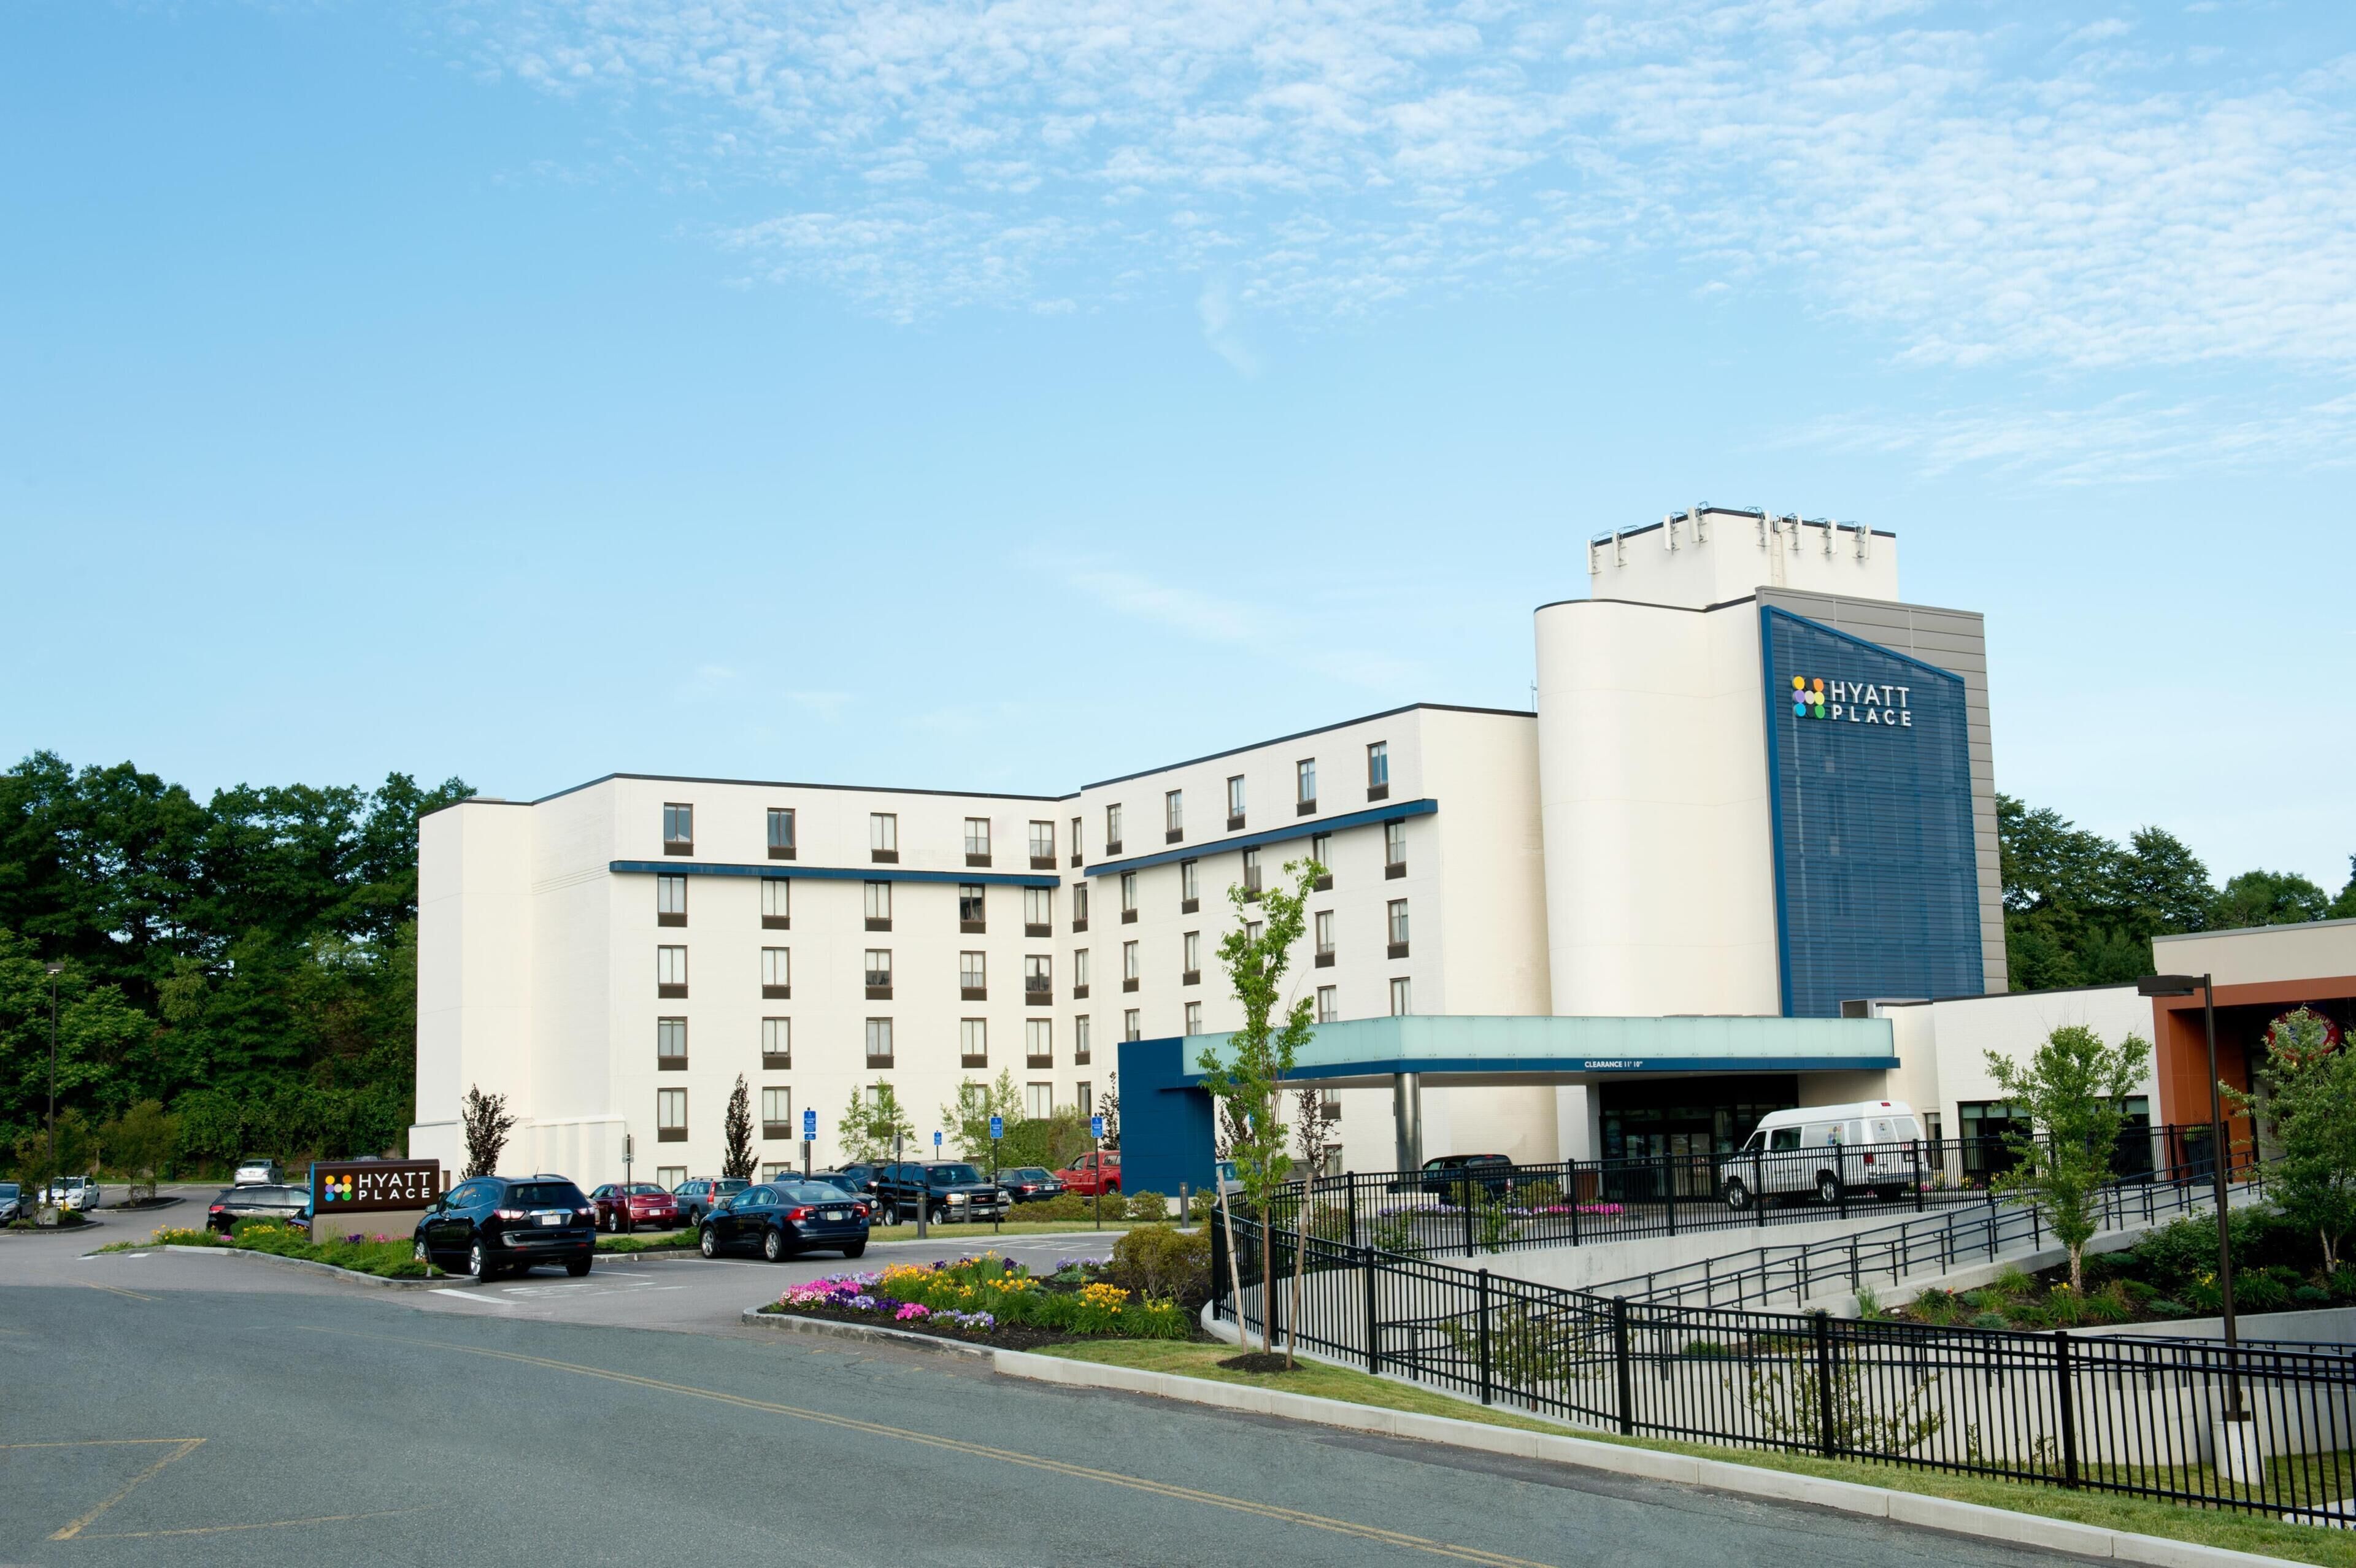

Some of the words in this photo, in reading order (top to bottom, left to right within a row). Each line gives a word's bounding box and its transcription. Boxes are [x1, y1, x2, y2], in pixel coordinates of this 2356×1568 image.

[1830, 680, 1910, 708] HYATT
[1831, 704, 1912, 727] PLACE
[358, 1172, 431, 1188] HYATT
[358, 1188, 430, 1201] PLACE
